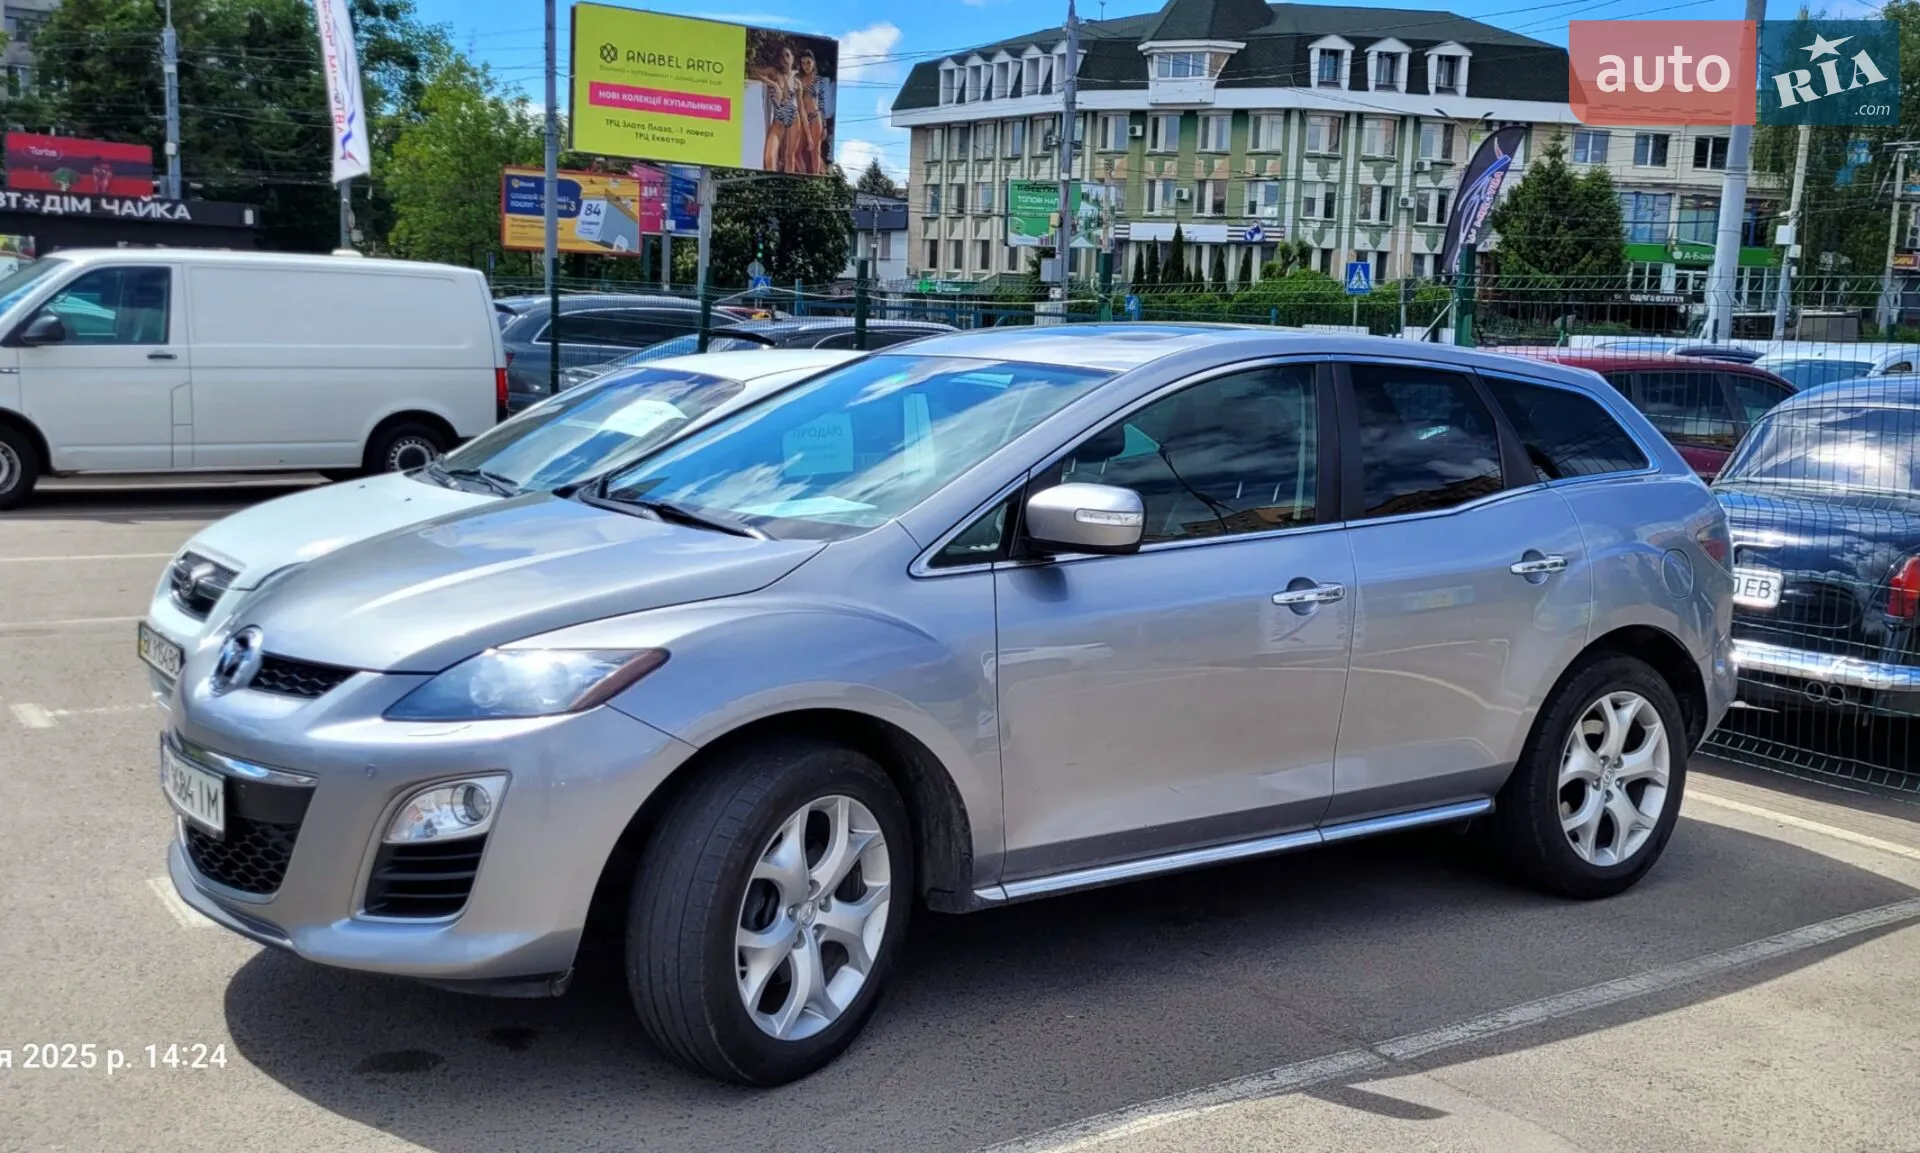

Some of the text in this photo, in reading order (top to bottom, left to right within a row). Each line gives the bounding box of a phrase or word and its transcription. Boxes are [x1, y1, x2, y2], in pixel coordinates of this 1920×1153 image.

[626, 49, 724, 74] ANABEL ARTO
[599, 90, 723, 113] НОВІ КОЛЕКЦІЇ КУПАЛЬНИКІВ
[605, 118, 621, 128] ТРЦ
[635, 132, 650, 142] ТРЦ
[102, 195, 192, 220] ЧАЙКА
[584, 204, 601, 216] 84
